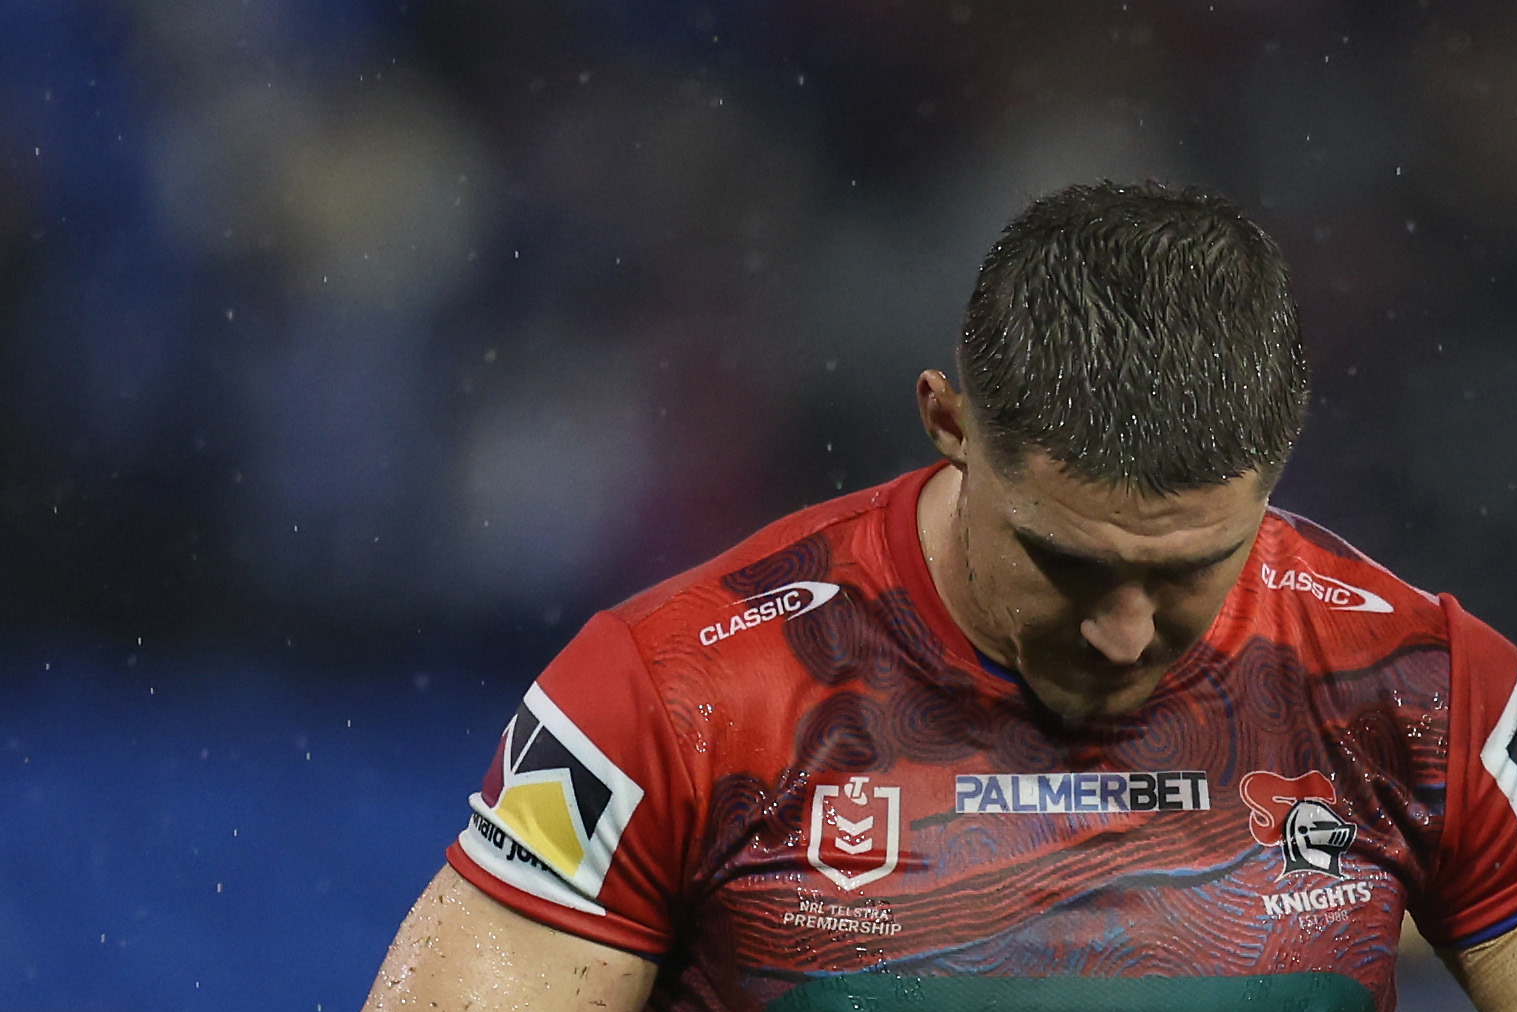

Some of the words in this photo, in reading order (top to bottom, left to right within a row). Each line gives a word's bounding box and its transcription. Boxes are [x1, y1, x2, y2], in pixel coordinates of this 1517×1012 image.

[1261, 563, 1351, 605] CLASSIC
[699, 590, 801, 646] CLASSIC
[956, 772, 1207, 812] PALMERBET
[799, 901, 825, 914] NRL
[829, 904, 889, 920] TELSTRA
[1262, 881, 1372, 916] KNIGHTS
[783, 912, 902, 936] PREMIERSHIP
